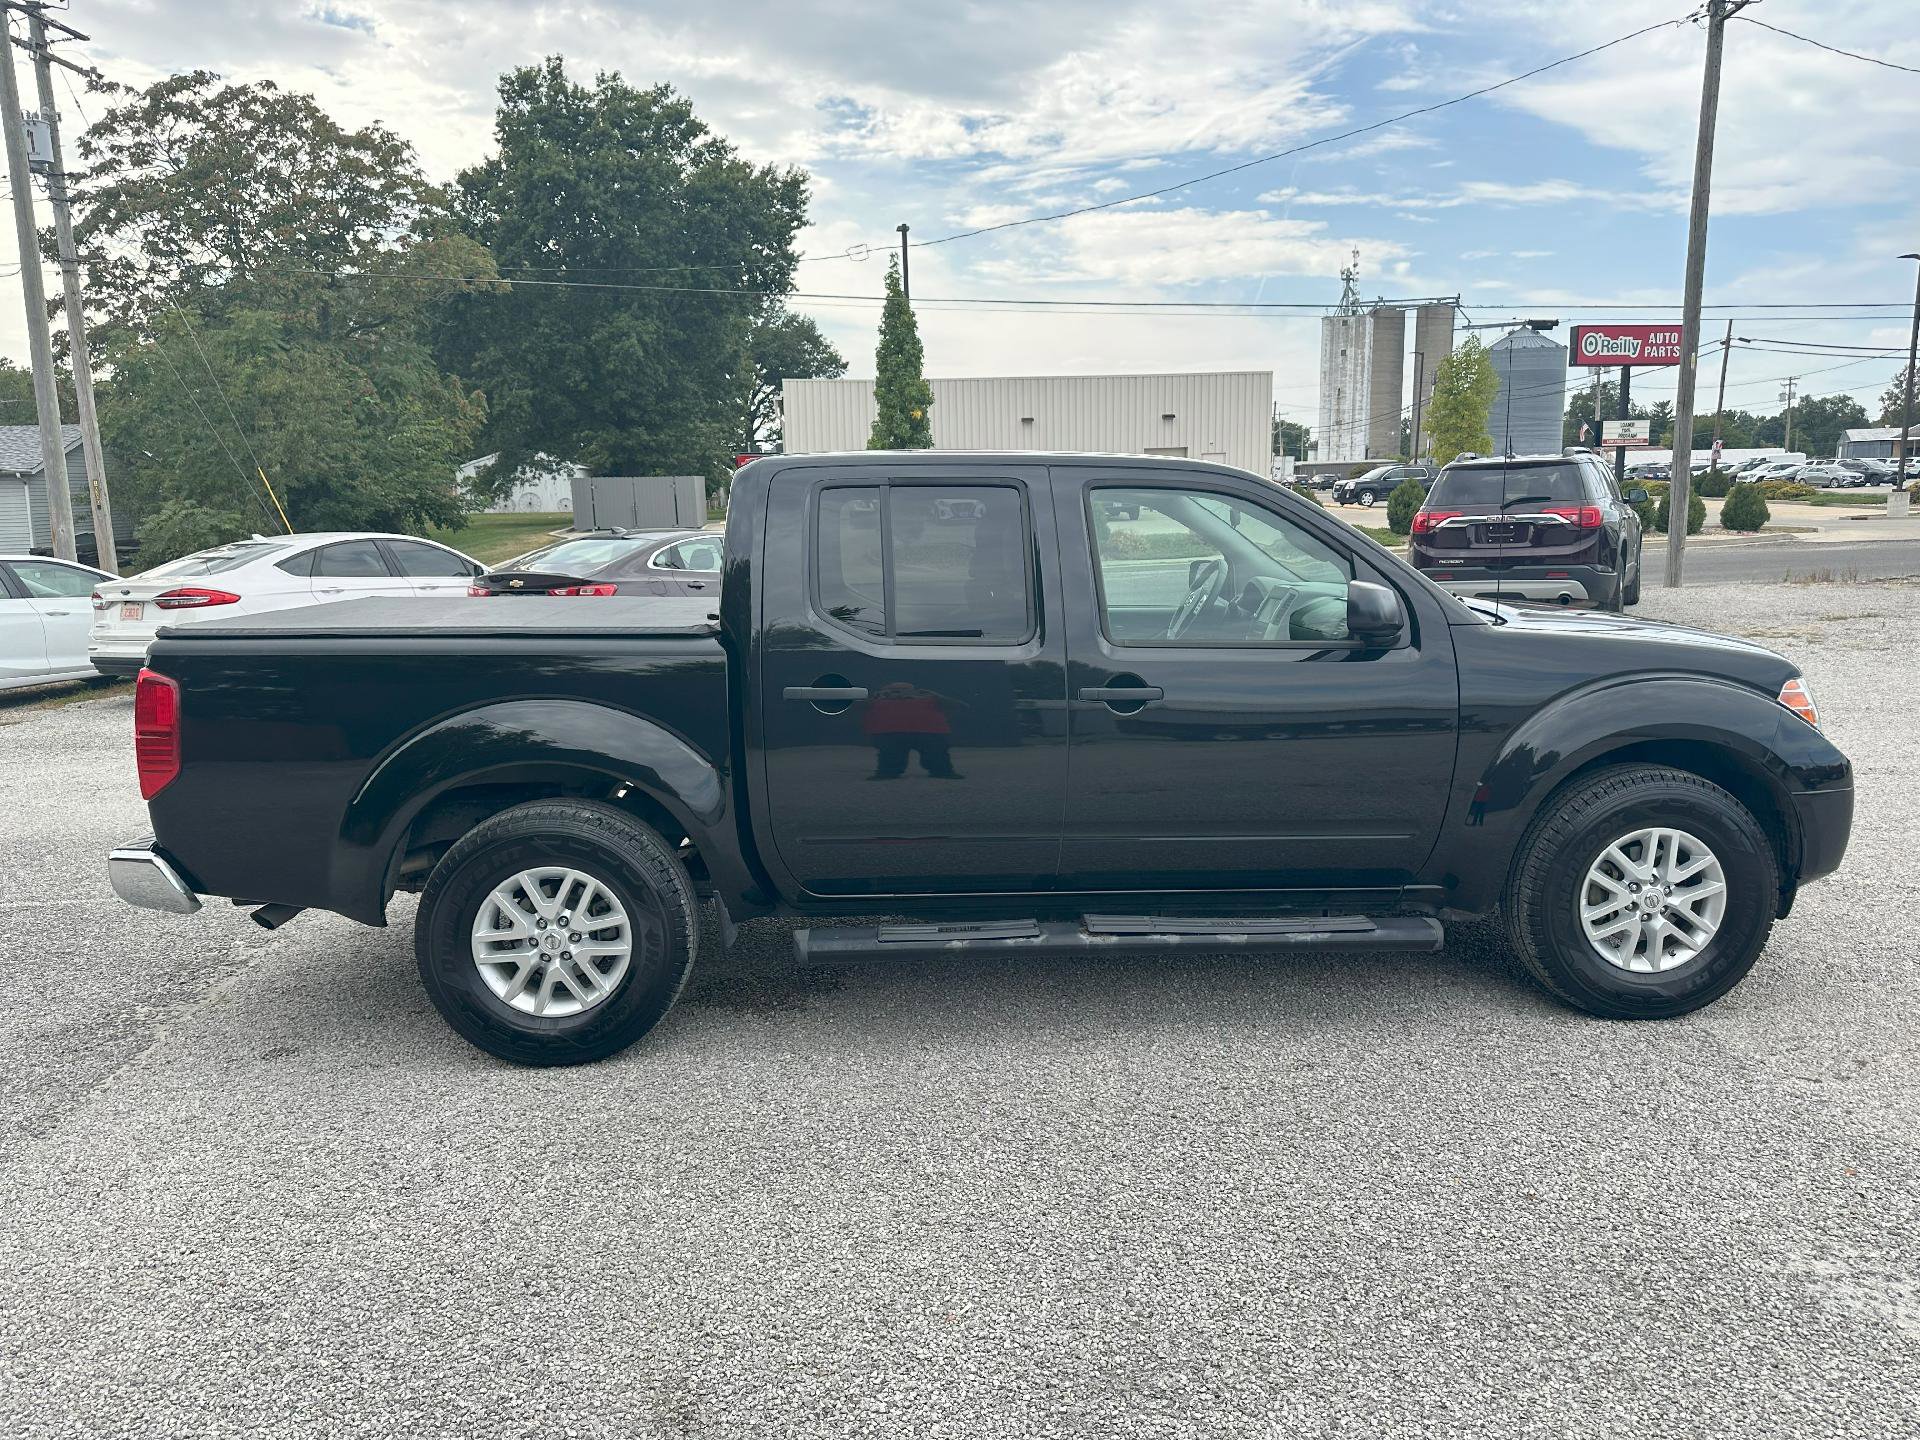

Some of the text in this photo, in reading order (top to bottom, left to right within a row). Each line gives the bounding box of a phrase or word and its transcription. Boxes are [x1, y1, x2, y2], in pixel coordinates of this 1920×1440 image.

[1648, 332, 1679, 344] AUTO
[1583, 333, 1641, 357] O'Reilly
[1644, 345, 1680, 357] PARTS
[1487, 516, 1516, 524] GMC
